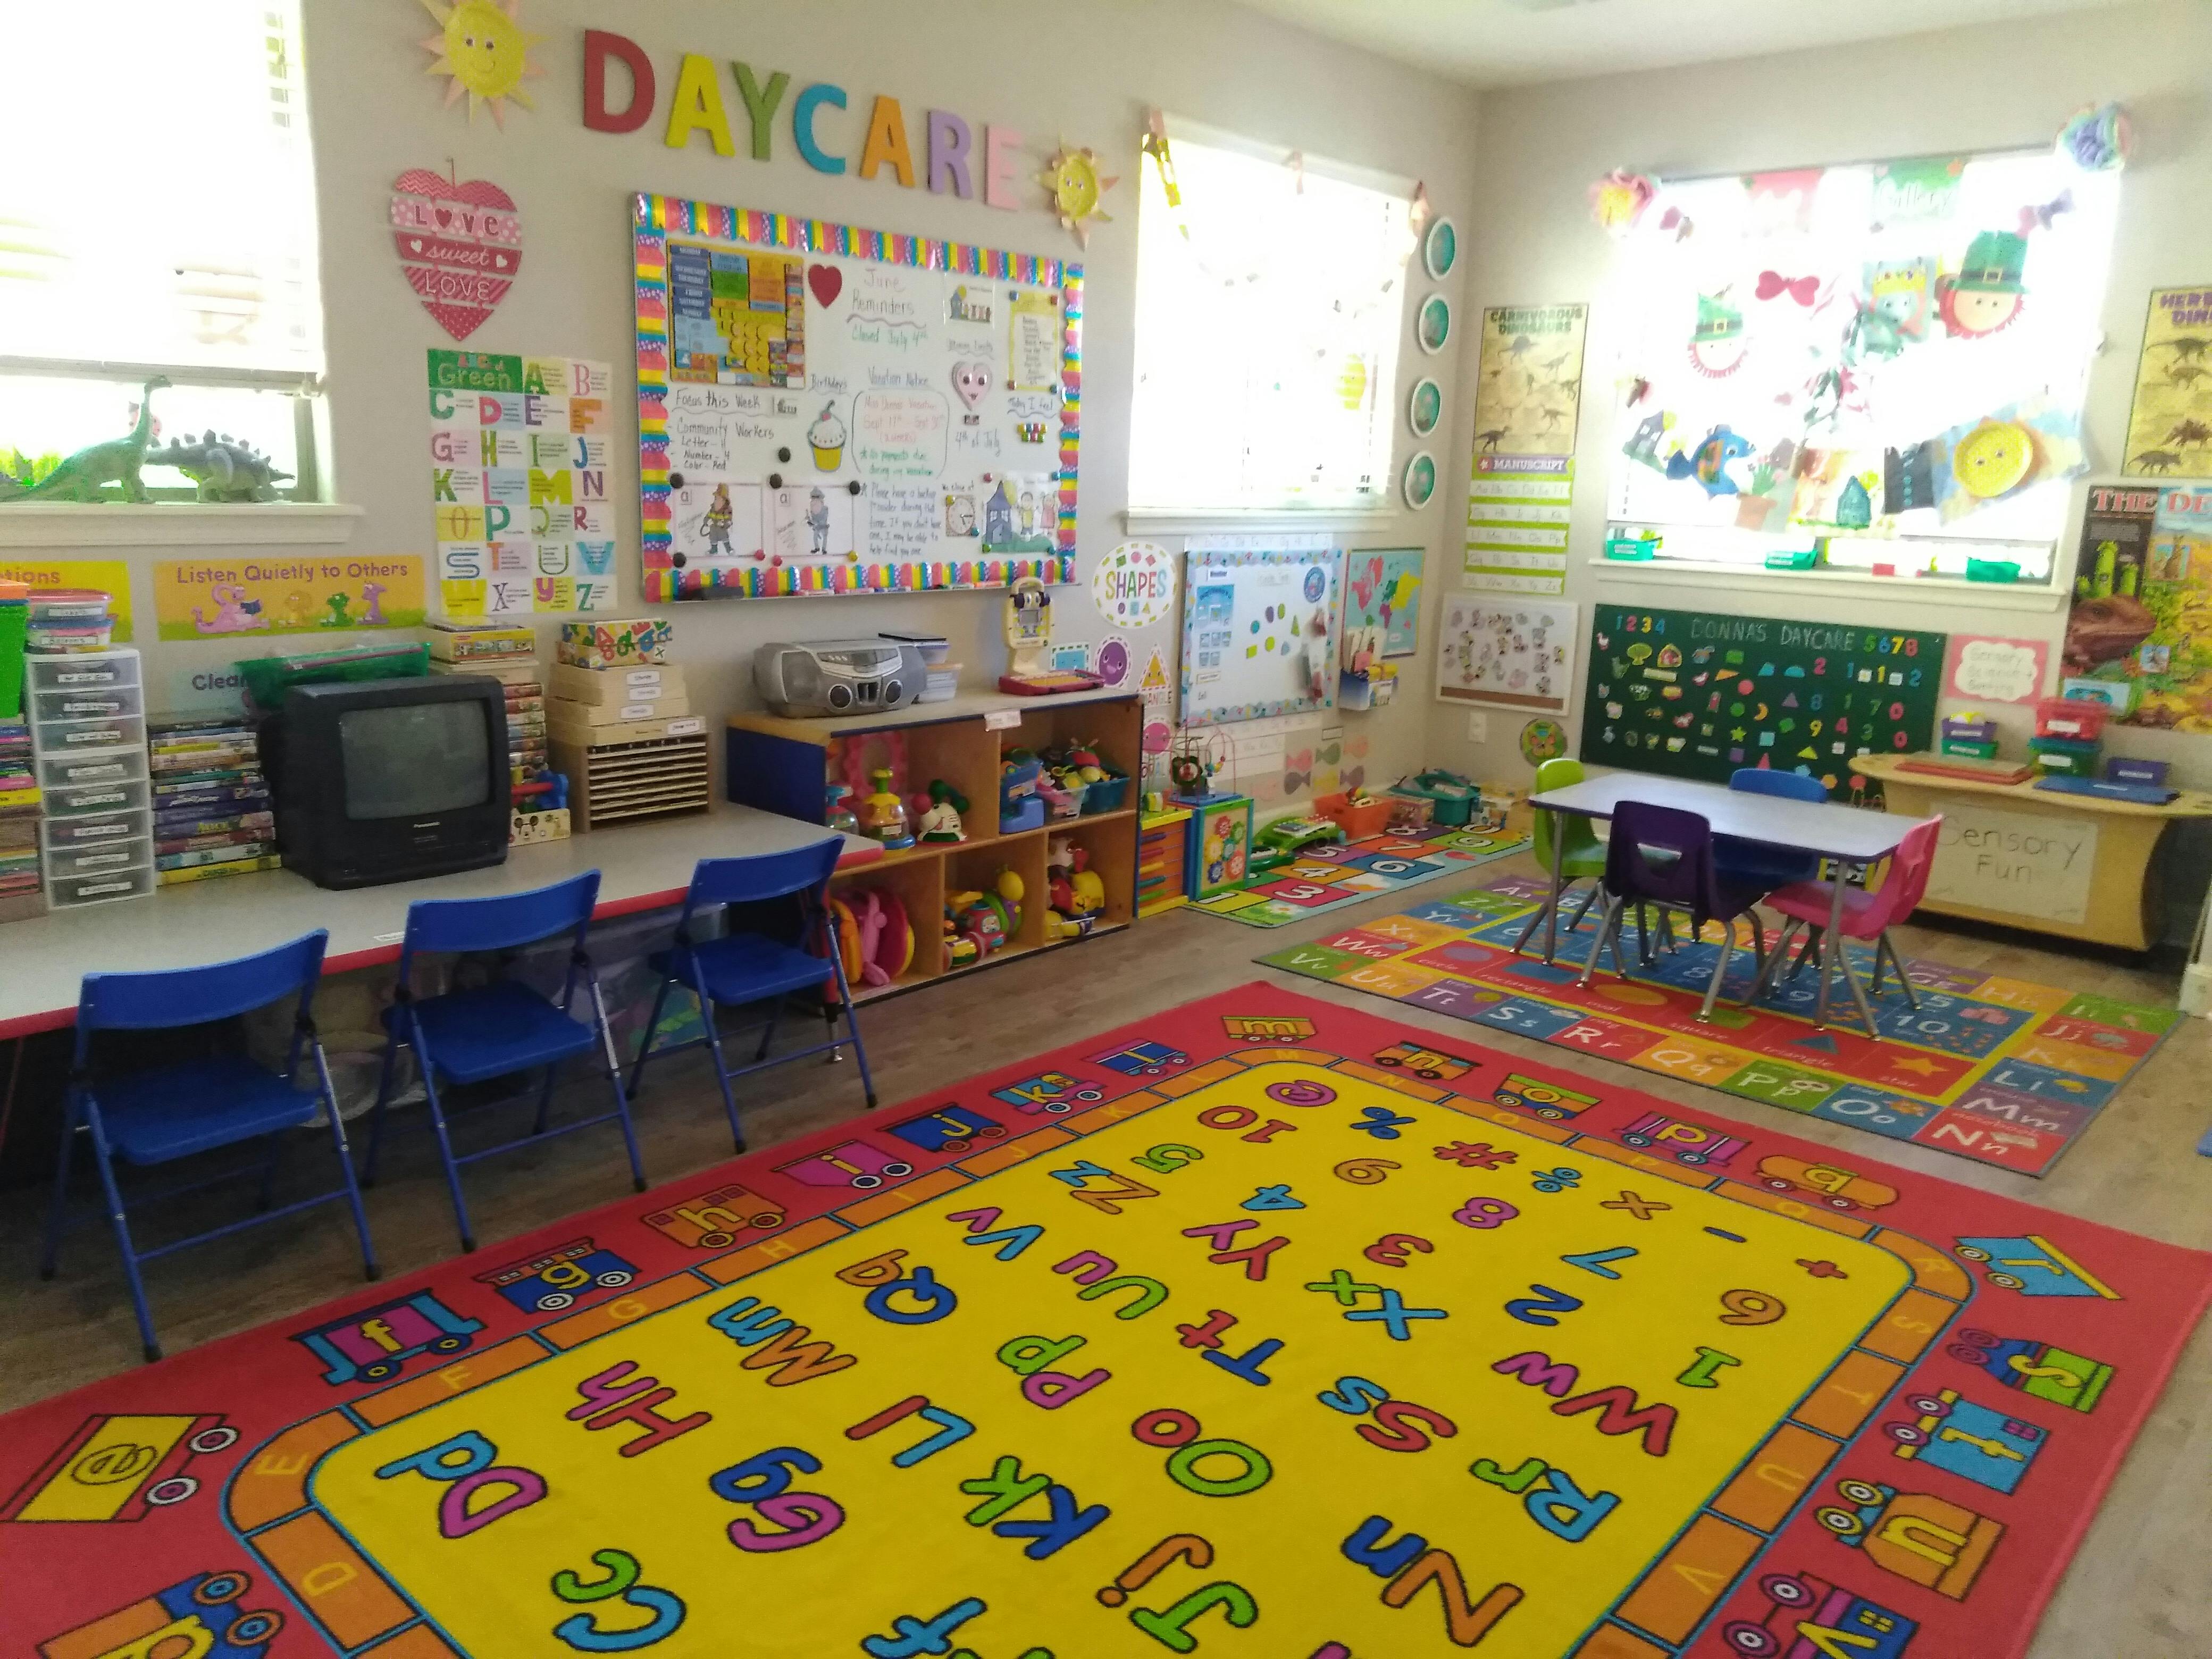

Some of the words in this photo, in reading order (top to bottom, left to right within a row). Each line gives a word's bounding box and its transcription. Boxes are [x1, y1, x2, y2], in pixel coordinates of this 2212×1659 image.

[584, 29, 1024, 211] DAYCARE
[426, 243, 490, 265] sweet
[425, 271, 490, 300] LOVE
[865, 268, 905, 292] June
[852, 289, 914, 315] Reminders
[438, 363, 511, 390] Green
[676, 389, 702, 406] Focus
[706, 390, 728, 408] this
[736, 392, 760, 409] Week
[677, 417, 727, 440] Community
[736, 423, 774, 439] Workers
[684, 450, 717, 460] Number
[713, 461, 727, 471] Red
[1493, 459, 1565, 471] MANUSCRIPT
[2092, 489, 2157, 513] THE
[0, 567, 60, 583] tions
[177, 564, 237, 584] Listen
[244, 564, 314, 584] Quietly
[321, 563, 341, 579] to
[347, 561, 408, 579] Others
[1105, 569, 1167, 600] SHAPES
[1780, 625, 1855, 652] DAYCARE
[1976, 854, 2032, 882] Fun
